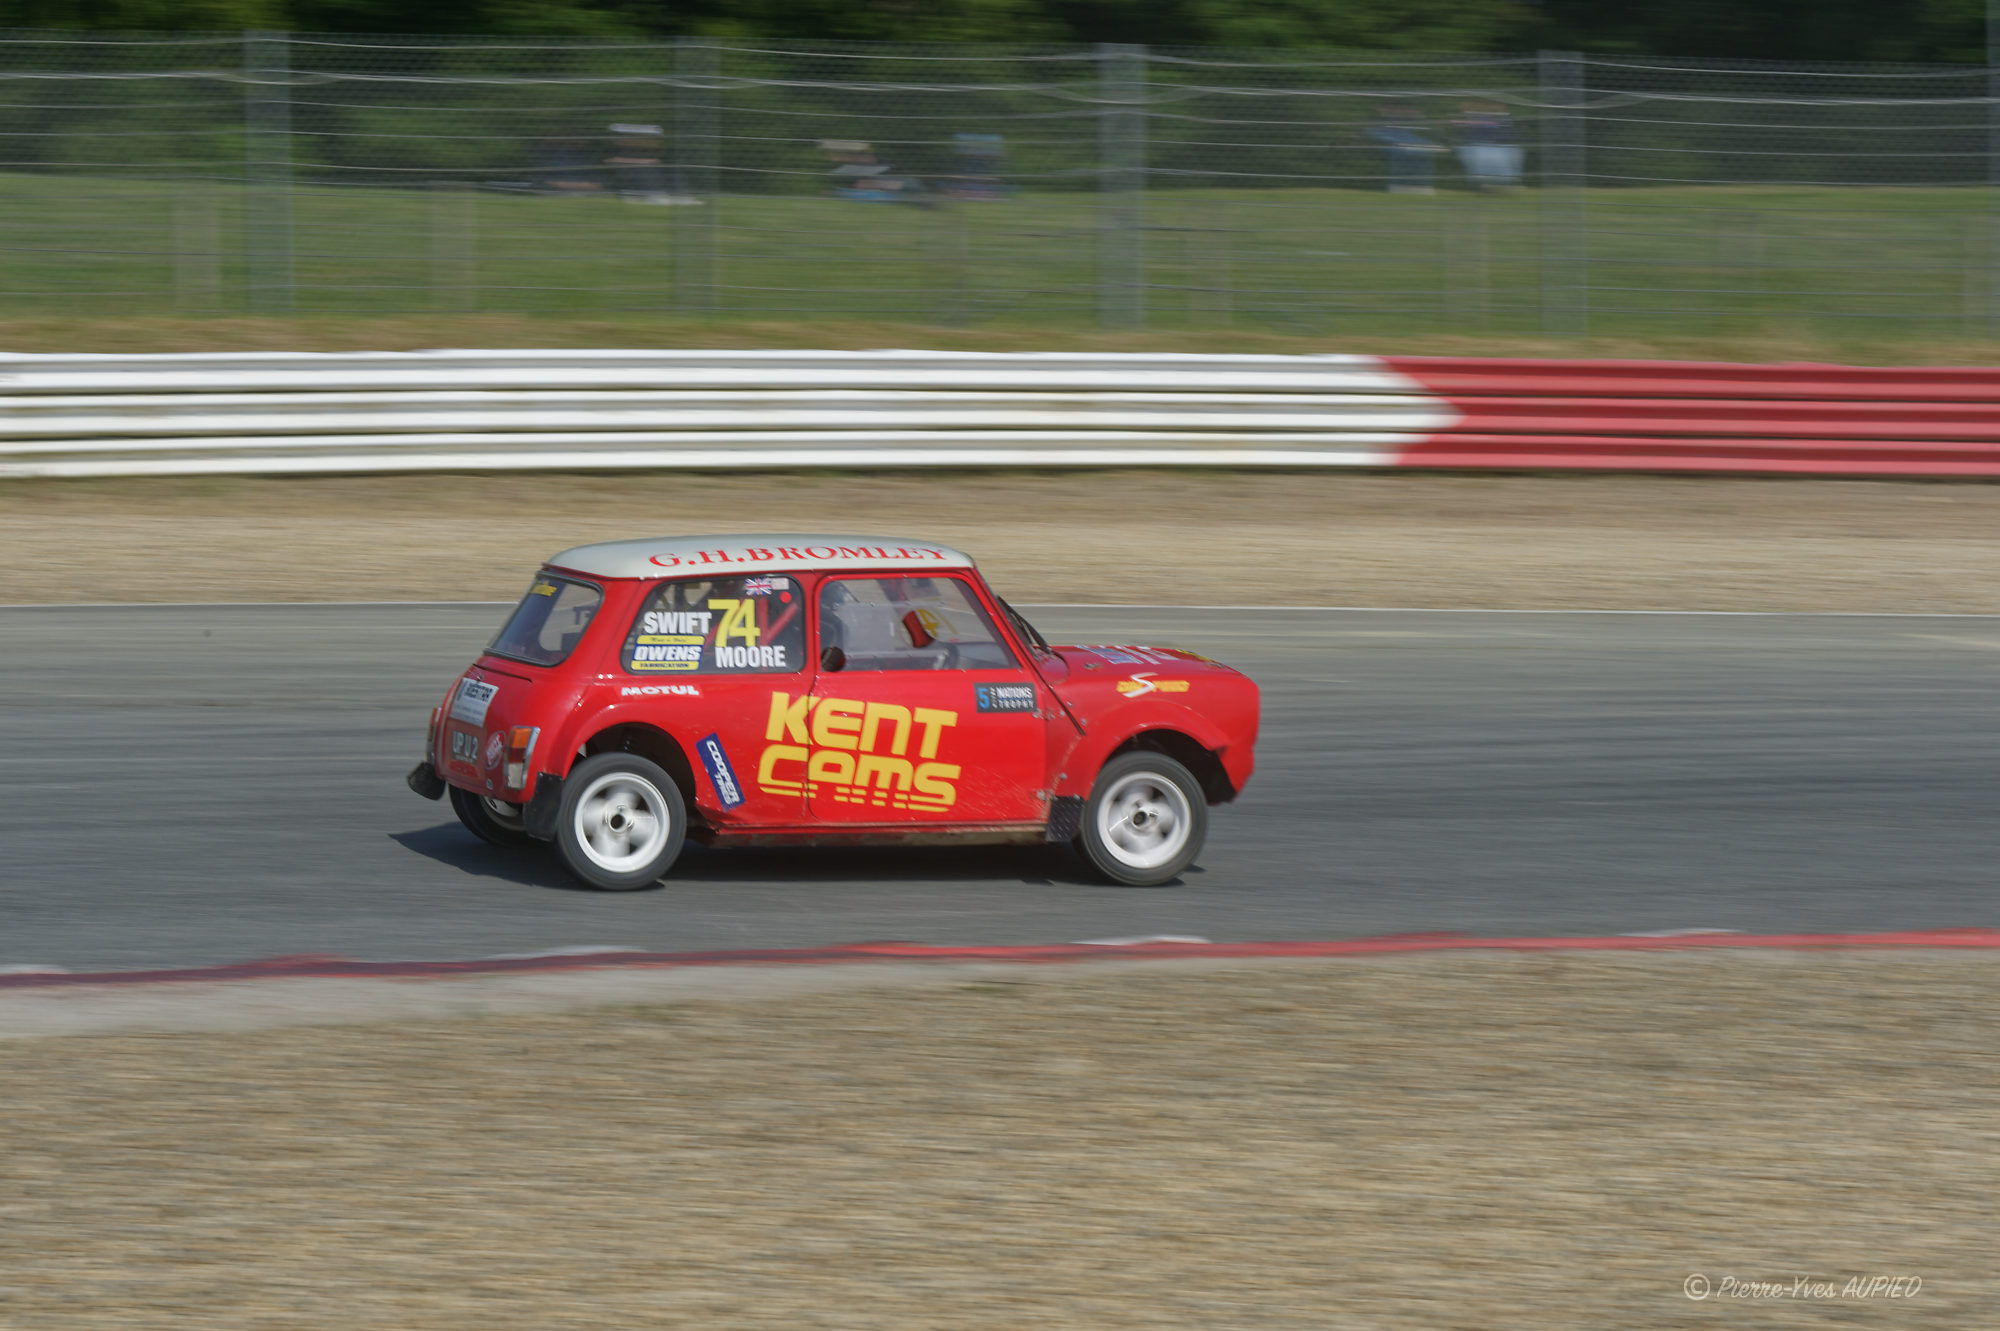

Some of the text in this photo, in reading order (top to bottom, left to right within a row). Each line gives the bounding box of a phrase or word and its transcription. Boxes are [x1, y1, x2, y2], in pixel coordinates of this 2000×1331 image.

[643, 611, 712, 634] SWIFT
[707, 598, 761, 648] 74
[634, 646, 702, 661] OWENS
[715, 645, 787, 668] MOORE
[621, 685, 700, 697] MOTUL
[977, 687, 989, 709] 5
[997, 687, 1032, 698] NATIONS
[706, 740, 740, 803] COOPER
